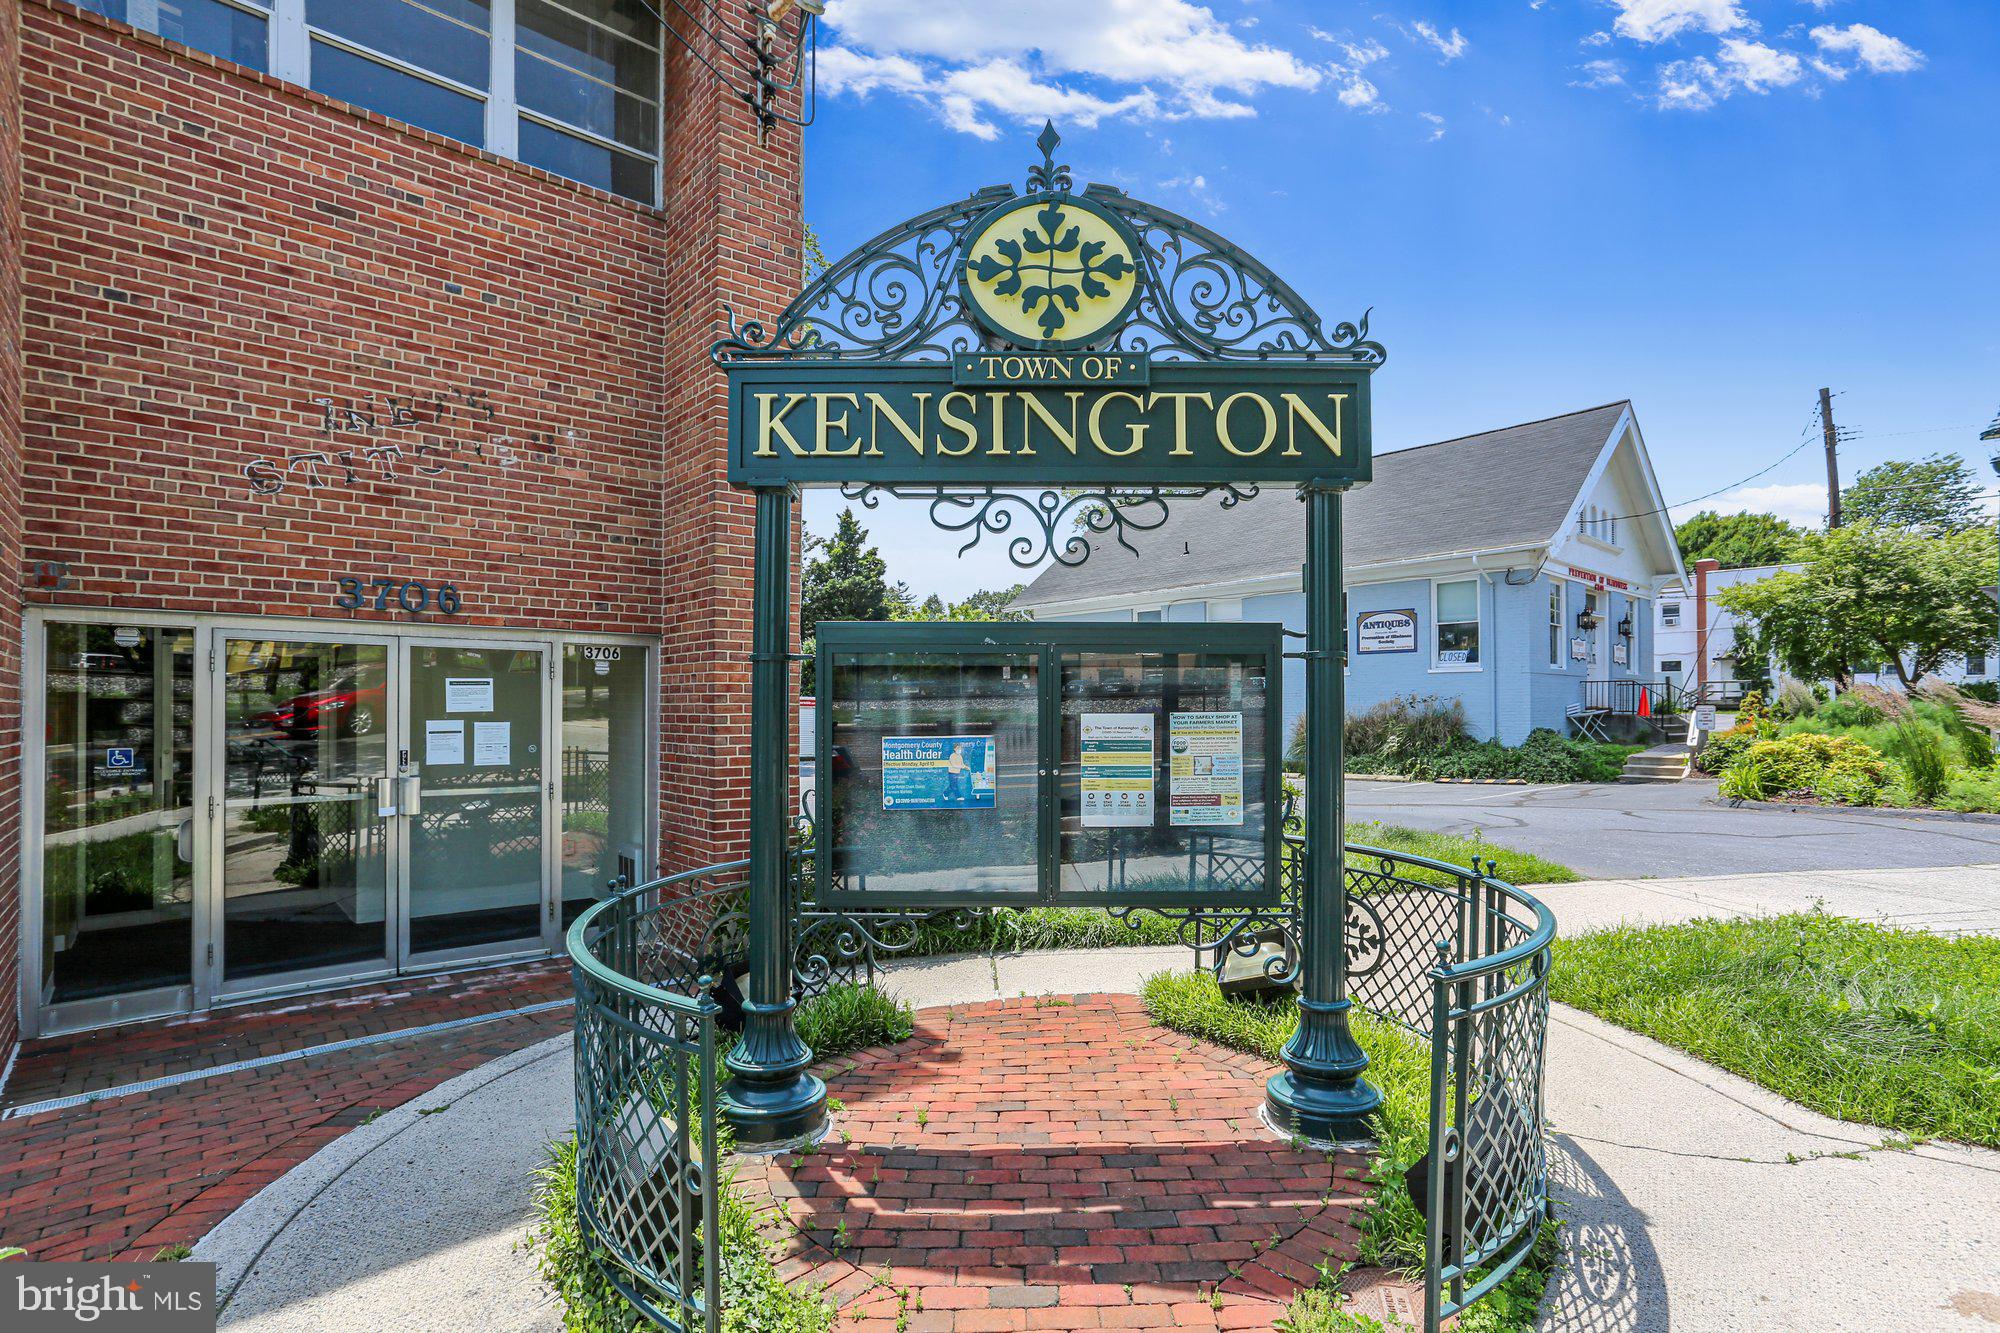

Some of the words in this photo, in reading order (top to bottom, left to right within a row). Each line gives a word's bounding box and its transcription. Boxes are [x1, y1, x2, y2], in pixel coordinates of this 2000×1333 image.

[980, 357, 1073, 380] TOWN
[1082, 357, 1122, 380] OF
[753, 390, 1349, 458] KENSINGTON
[338, 578, 461, 614] 3706
[1363, 619, 1410, 630] ANTIQUES
[586, 647, 619, 659] 3706
[1440, 652, 1466, 661] CLOSED
[883, 742, 920, 750] Montgomery
[921, 741, 942, 749] County
[883, 750, 913, 760] Health
[916, 750, 942, 759] Order
